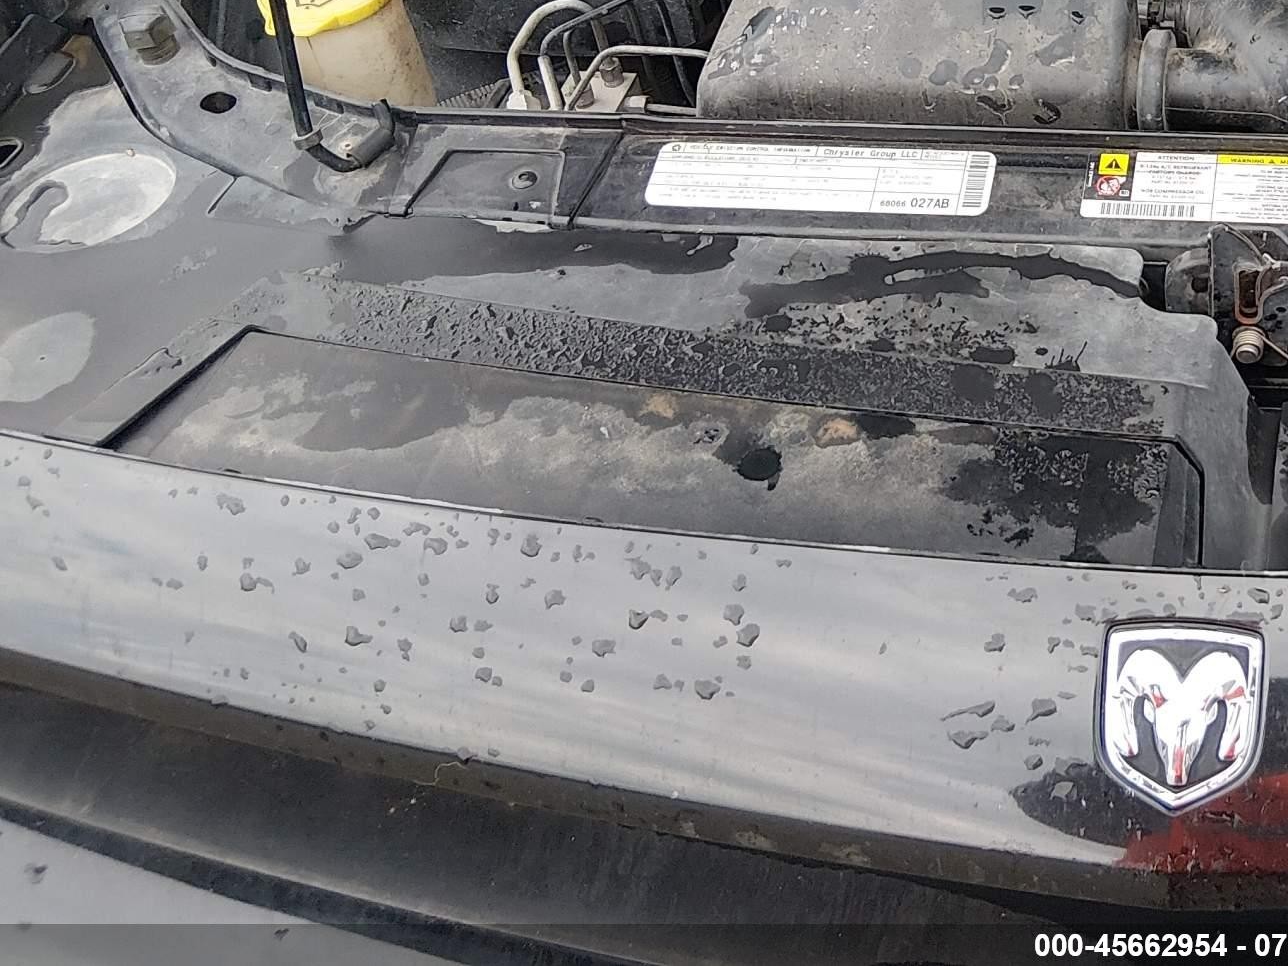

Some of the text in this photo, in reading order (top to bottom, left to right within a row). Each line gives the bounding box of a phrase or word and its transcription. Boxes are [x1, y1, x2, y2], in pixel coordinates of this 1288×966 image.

[823, 148, 865, 158] Chrysler
[870, 150, 897, 159] Group
[910, 198, 951, 209] 027AB
